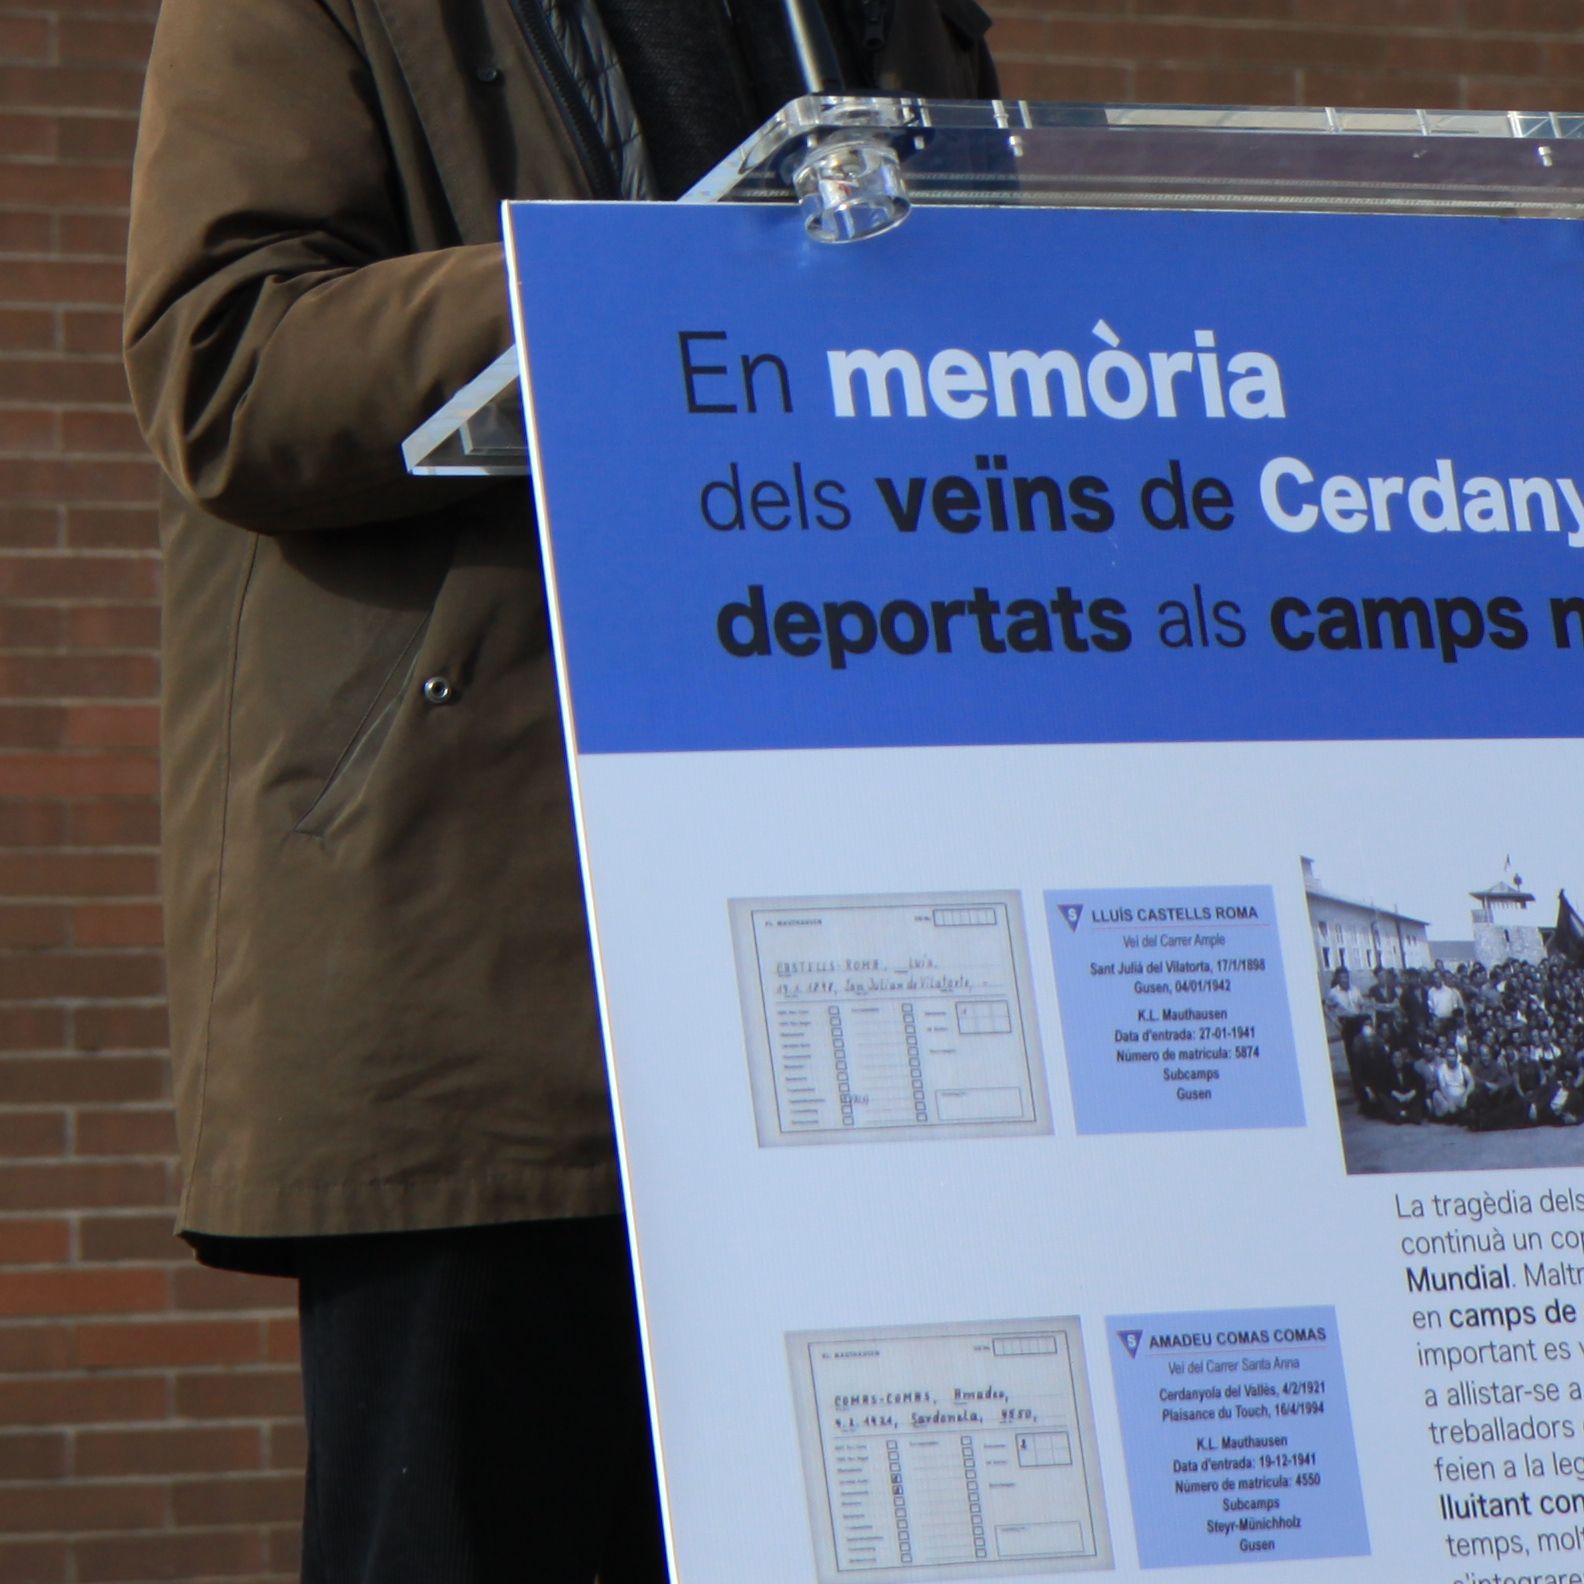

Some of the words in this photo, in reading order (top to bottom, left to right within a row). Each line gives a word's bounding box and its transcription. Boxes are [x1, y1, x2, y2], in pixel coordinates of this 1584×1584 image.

[678, 330, 794, 414] En
[826, 319, 1286, 419] memòria
[700, 461, 851, 531] dels
[875, 454, 1115, 534] veïns
[1139, 459, 1235, 530] de
[716, 584, 1132, 669] deportats
[1157, 583, 1247, 649] als
[1269, 595, 1528, 663] camps
[1137, 907, 1211, 922] CASTELLS
[1215, 906, 1258, 919] ROMA
[1142, 934, 1157, 948] del
[1159, 934, 1192, 947] Carrer
[1194, 933, 1226, 948] Ample
[1090, 961, 1115, 976] Sant
[1146, 960, 1163, 974] del
[1165, 959, 1214, 975] Vilatorta,
[1217, 957, 1266, 971] 17/1/1898
[1134, 980, 1172, 995] Gusen,
[1174, 978, 1231, 992] 04/01/1942
[1137, 1008, 1160, 1022] K.L.
[1162, 1008, 1228, 1021] Mauthausen
[1114, 1028, 1139, 1043] Data
[1142, 1027, 1196, 1042] d'entrada:
[1199, 1026, 1255, 1040] 27-01-1941
[1162, 1047, 1175, 1061] de
[1235, 1045, 1259, 1059] 5874
[1163, 1067, 1220, 1082] Subcamps
[1176, 1087, 1212, 1100] Gusen
[1395, 1193, 1425, 1218] La
[1431, 1190, 1533, 1222] tragèdia
[1401, 1227, 1506, 1256] continuà
[1512, 1231, 1543, 1251] un
[1406, 1263, 1517, 1293] Mundial.
[1412, 1308, 1442, 1329] en
[1449, 1304, 1537, 1331] camps
[1544, 1298, 1577, 1324] de
[1149, 1332, 1212, 1349] AMADEU
[1216, 1330, 1270, 1345] COMAS
[1273, 1328, 1327, 1342] COMAS
[1187, 1360, 1204, 1373] del
[1206, 1359, 1239, 1373] Carrer
[1241, 1357, 1272, 1372] Santa
[1273, 1356, 1300, 1370] Anna
[1416, 1338, 1537, 1371] important
[1544, 1341, 1571, 1361] es
[1159, 1385, 1222, 1403] Cerdanyola
[1224, 1384, 1241, 1398] del
[1282, 1380, 1326, 1395] 4/2/1921
[1424, 1387, 1438, 1407] a
[1447, 1380, 1560, 1406] allistar-se
[1568, 1381, 1582, 1400] a
[1162, 1406, 1216, 1423] Plaisance
[1218, 1405, 1232, 1419] du
[1235, 1403, 1272, 1419] Touch,
[1275, 1401, 1325, 1416] 16/4/1994
[1428, 1415, 1575, 1445] treballadors
[1196, 1436, 1218, 1452] K.L.
[1221, 1434, 1288, 1449] Mauthausen
[1173, 1459, 1198, 1474] Data
[1201, 1455, 1256, 1472] d'entrada:
[1259, 1453, 1316, 1468] 19-12-1941
[1434, 1455, 1496, 1482] feien
[1503, 1459, 1517, 1478] a
[1524, 1452, 1545, 1478] la
[1222, 1477, 1236, 1491] de
[1295, 1472, 1321, 1486] 4550
[1222, 1496, 1280, 1511] Subcamps
[1440, 1491, 1533, 1521] lluitant
[1239, 1538, 1275, 1553] Gusen
[1445, 1534, 1530, 1561] temps,
